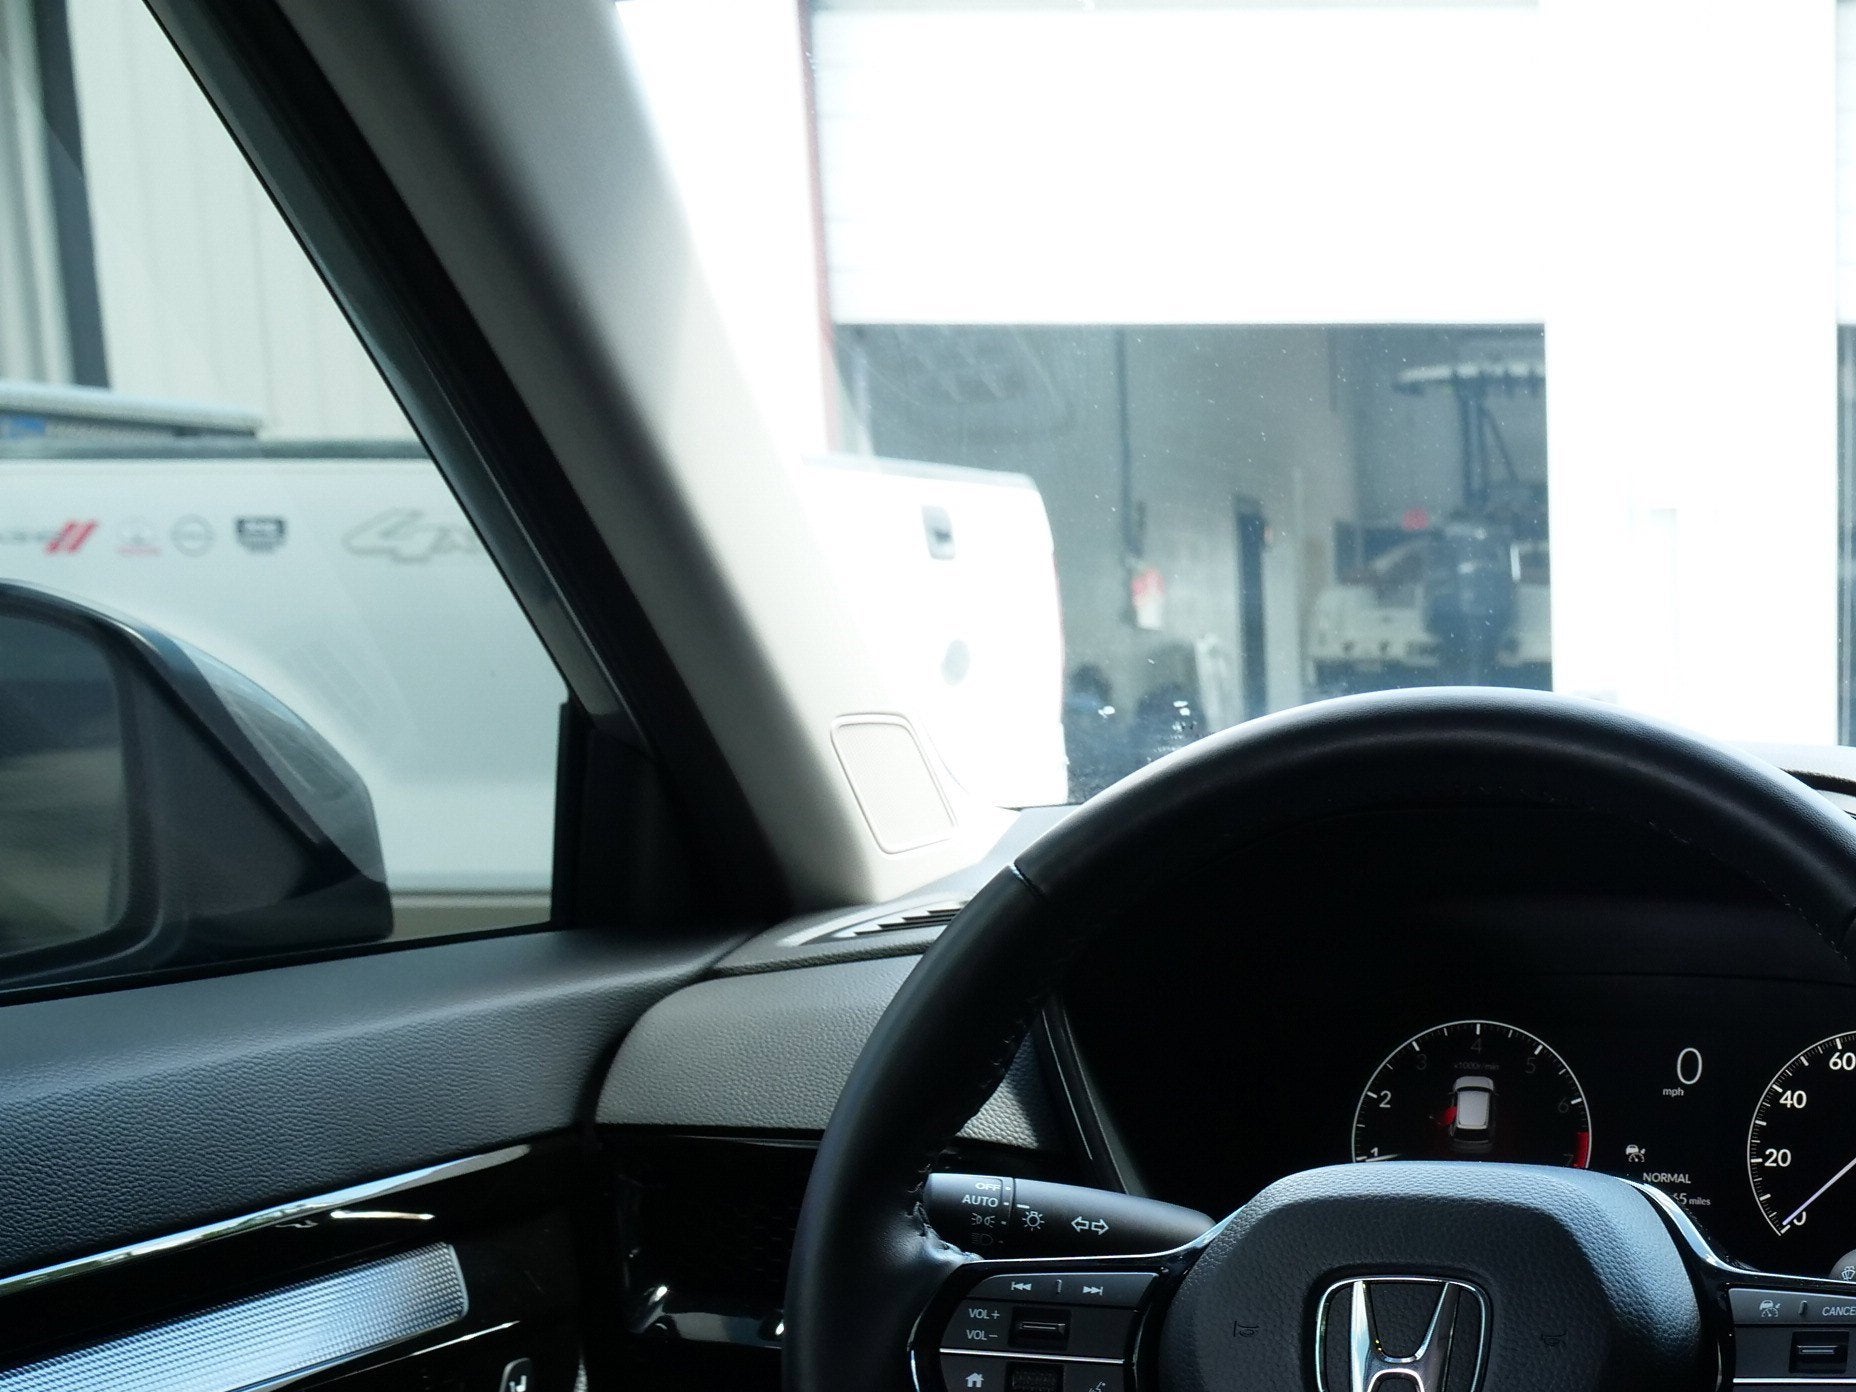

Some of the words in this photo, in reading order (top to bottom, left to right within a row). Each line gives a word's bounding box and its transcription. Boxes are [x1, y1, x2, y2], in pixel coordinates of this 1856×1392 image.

[1676, 1047, 1703, 1085] 0
[1828, 1051, 1856, 1071] 60
[1378, 1089, 1392, 1109] 2
[1662, 1087, 1684, 1098] mph
[1779, 1090, 1807, 1109] 40
[1764, 1149, 1792, 1168] 20
[974, 1181, 1001, 1191] OFF
[1642, 1172, 1691, 1184] NORMAL
[962, 1194, 999, 1208] AUTO
[1688, 1196, 1711, 1206] miles
